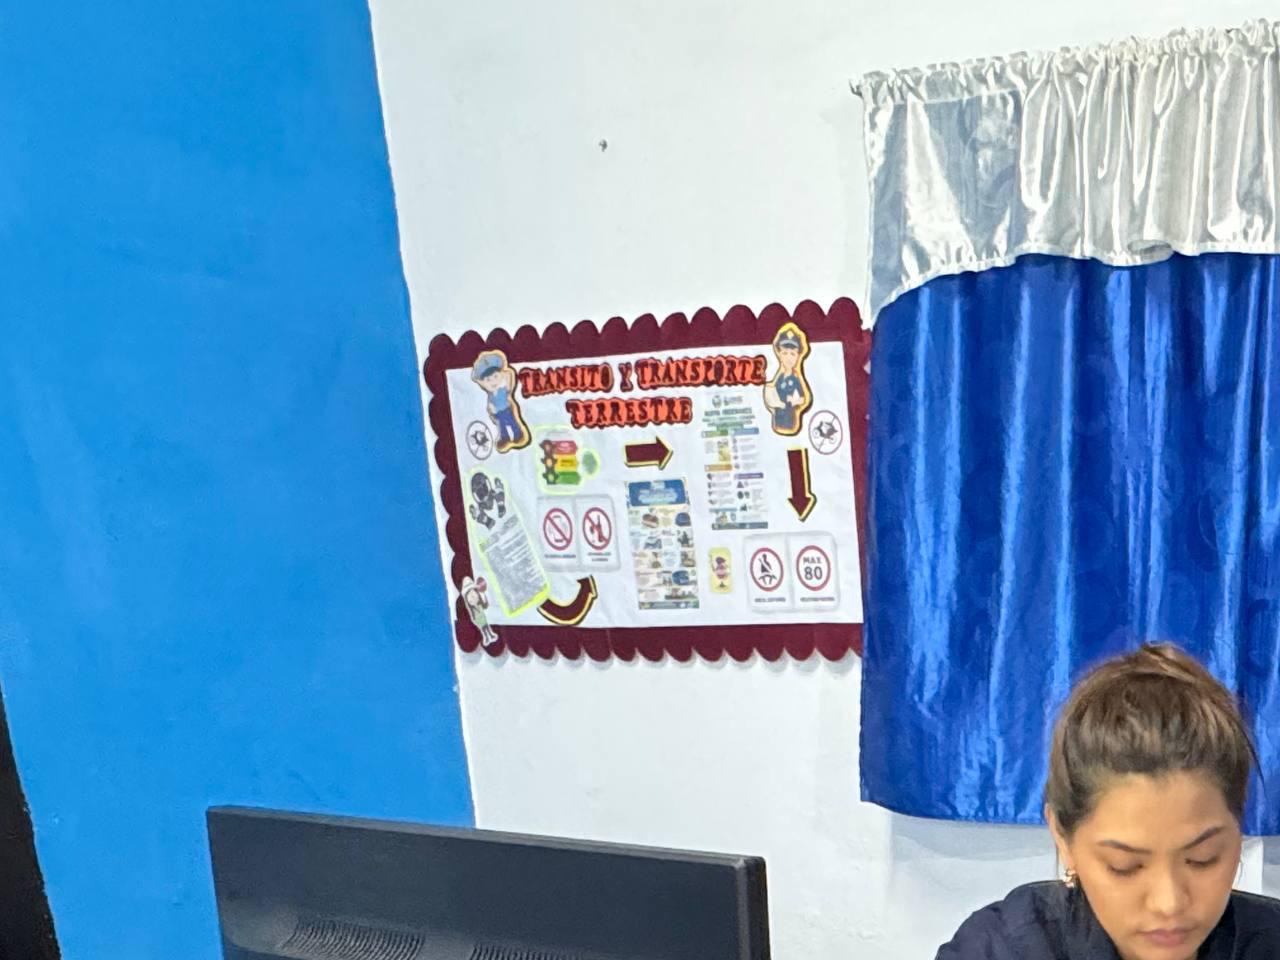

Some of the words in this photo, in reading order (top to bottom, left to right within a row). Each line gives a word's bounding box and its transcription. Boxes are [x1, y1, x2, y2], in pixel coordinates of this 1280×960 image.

[518, 362, 614, 397] TRANSITO
[618, 362, 633, 392] Y
[635, 355, 767, 389] TRANSPORTE
[566, 397, 693, 428] TERRESTRE
[804, 566, 823, 581] 80
